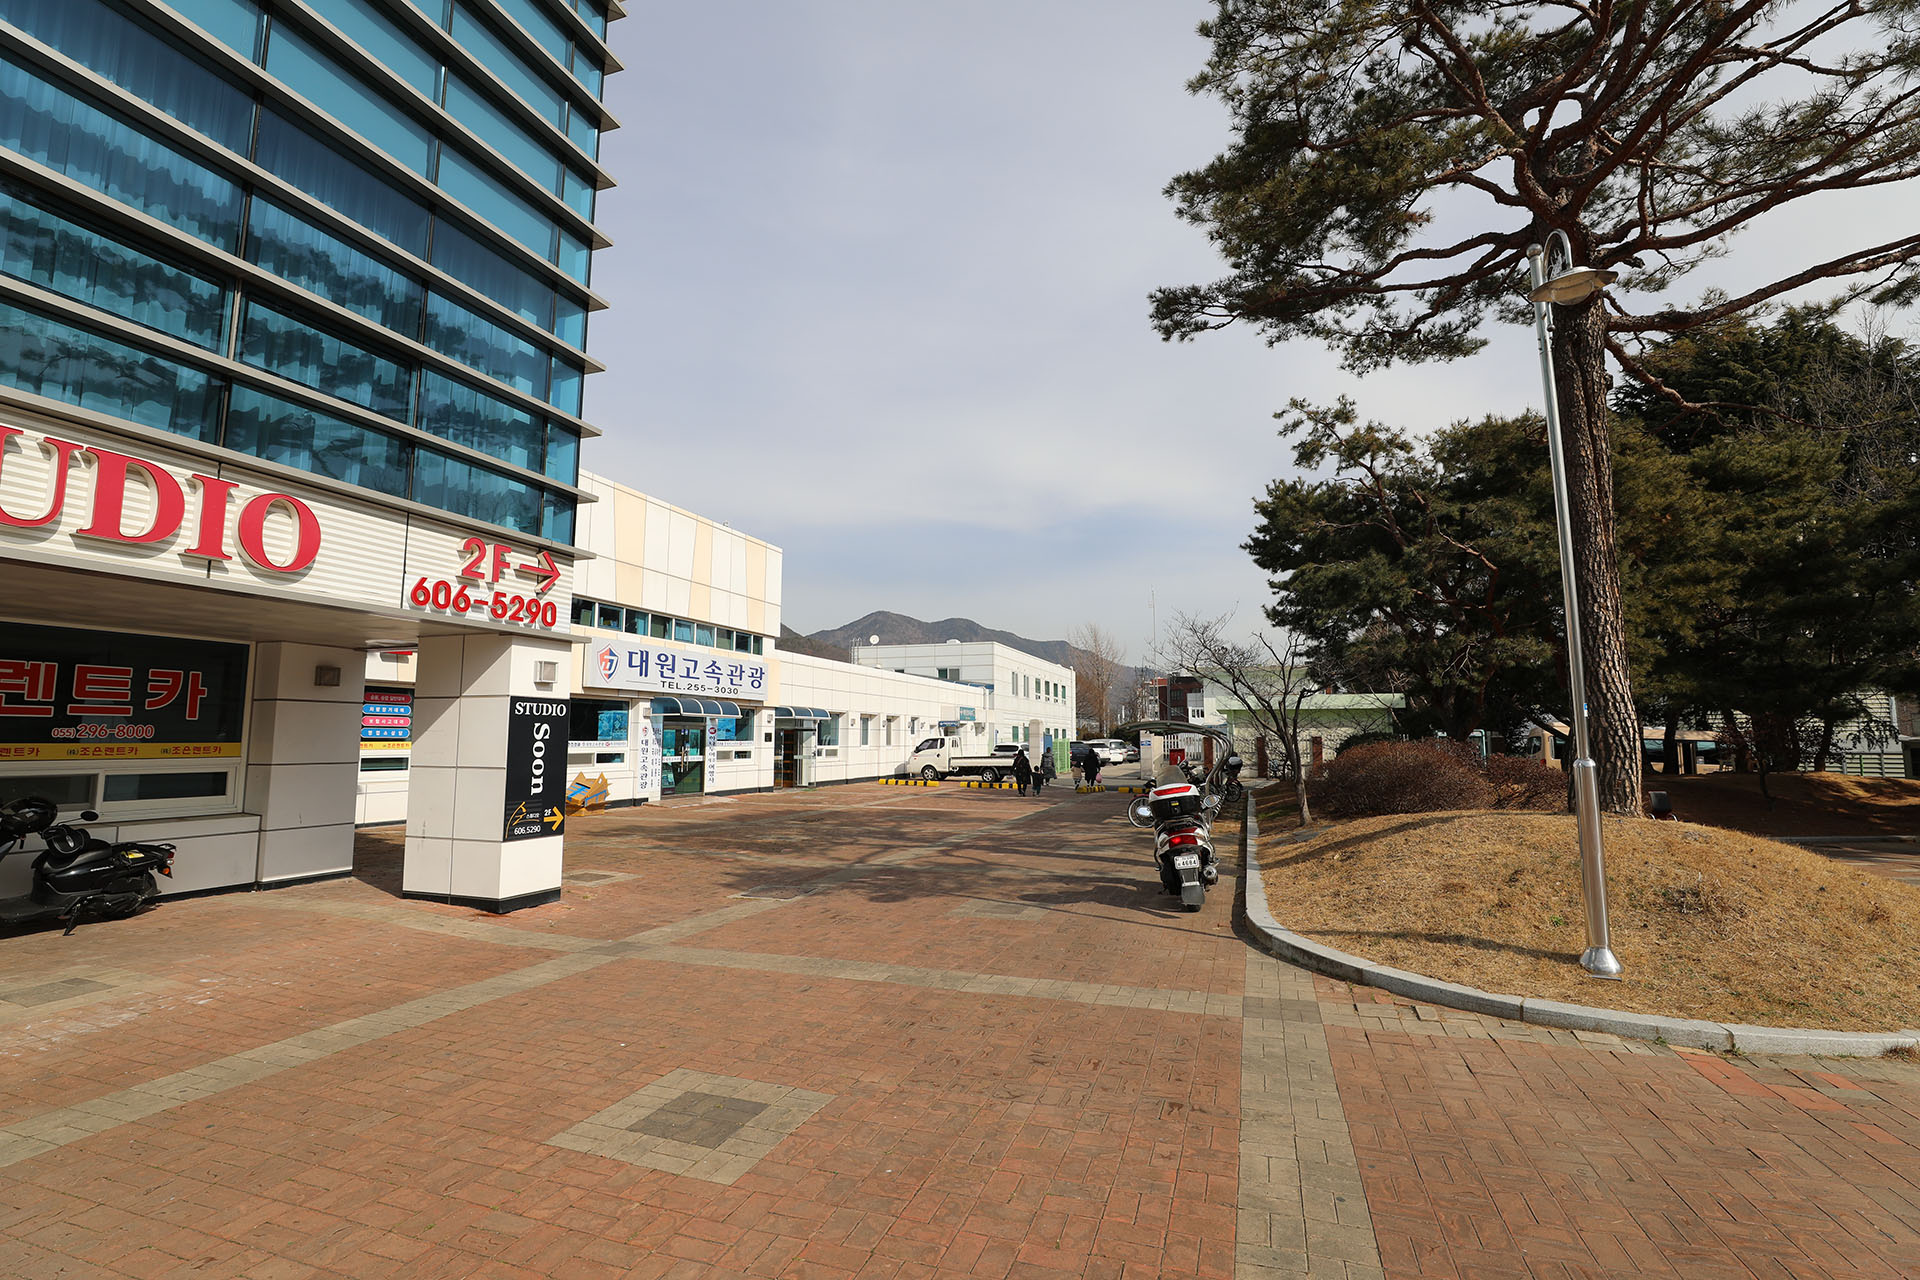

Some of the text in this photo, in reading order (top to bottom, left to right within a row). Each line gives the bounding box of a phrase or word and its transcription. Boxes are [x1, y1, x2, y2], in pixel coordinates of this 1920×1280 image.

[462, 537, 512, 583] 2F
[410, 577, 557, 627] 606-5290
[628, 649, 765, 689] 대원고속관광
[660, 680, 739, 695] TEL.255-3030
[514, 701, 567, 717] STUDIO
[530, 722, 551, 795] Soon
